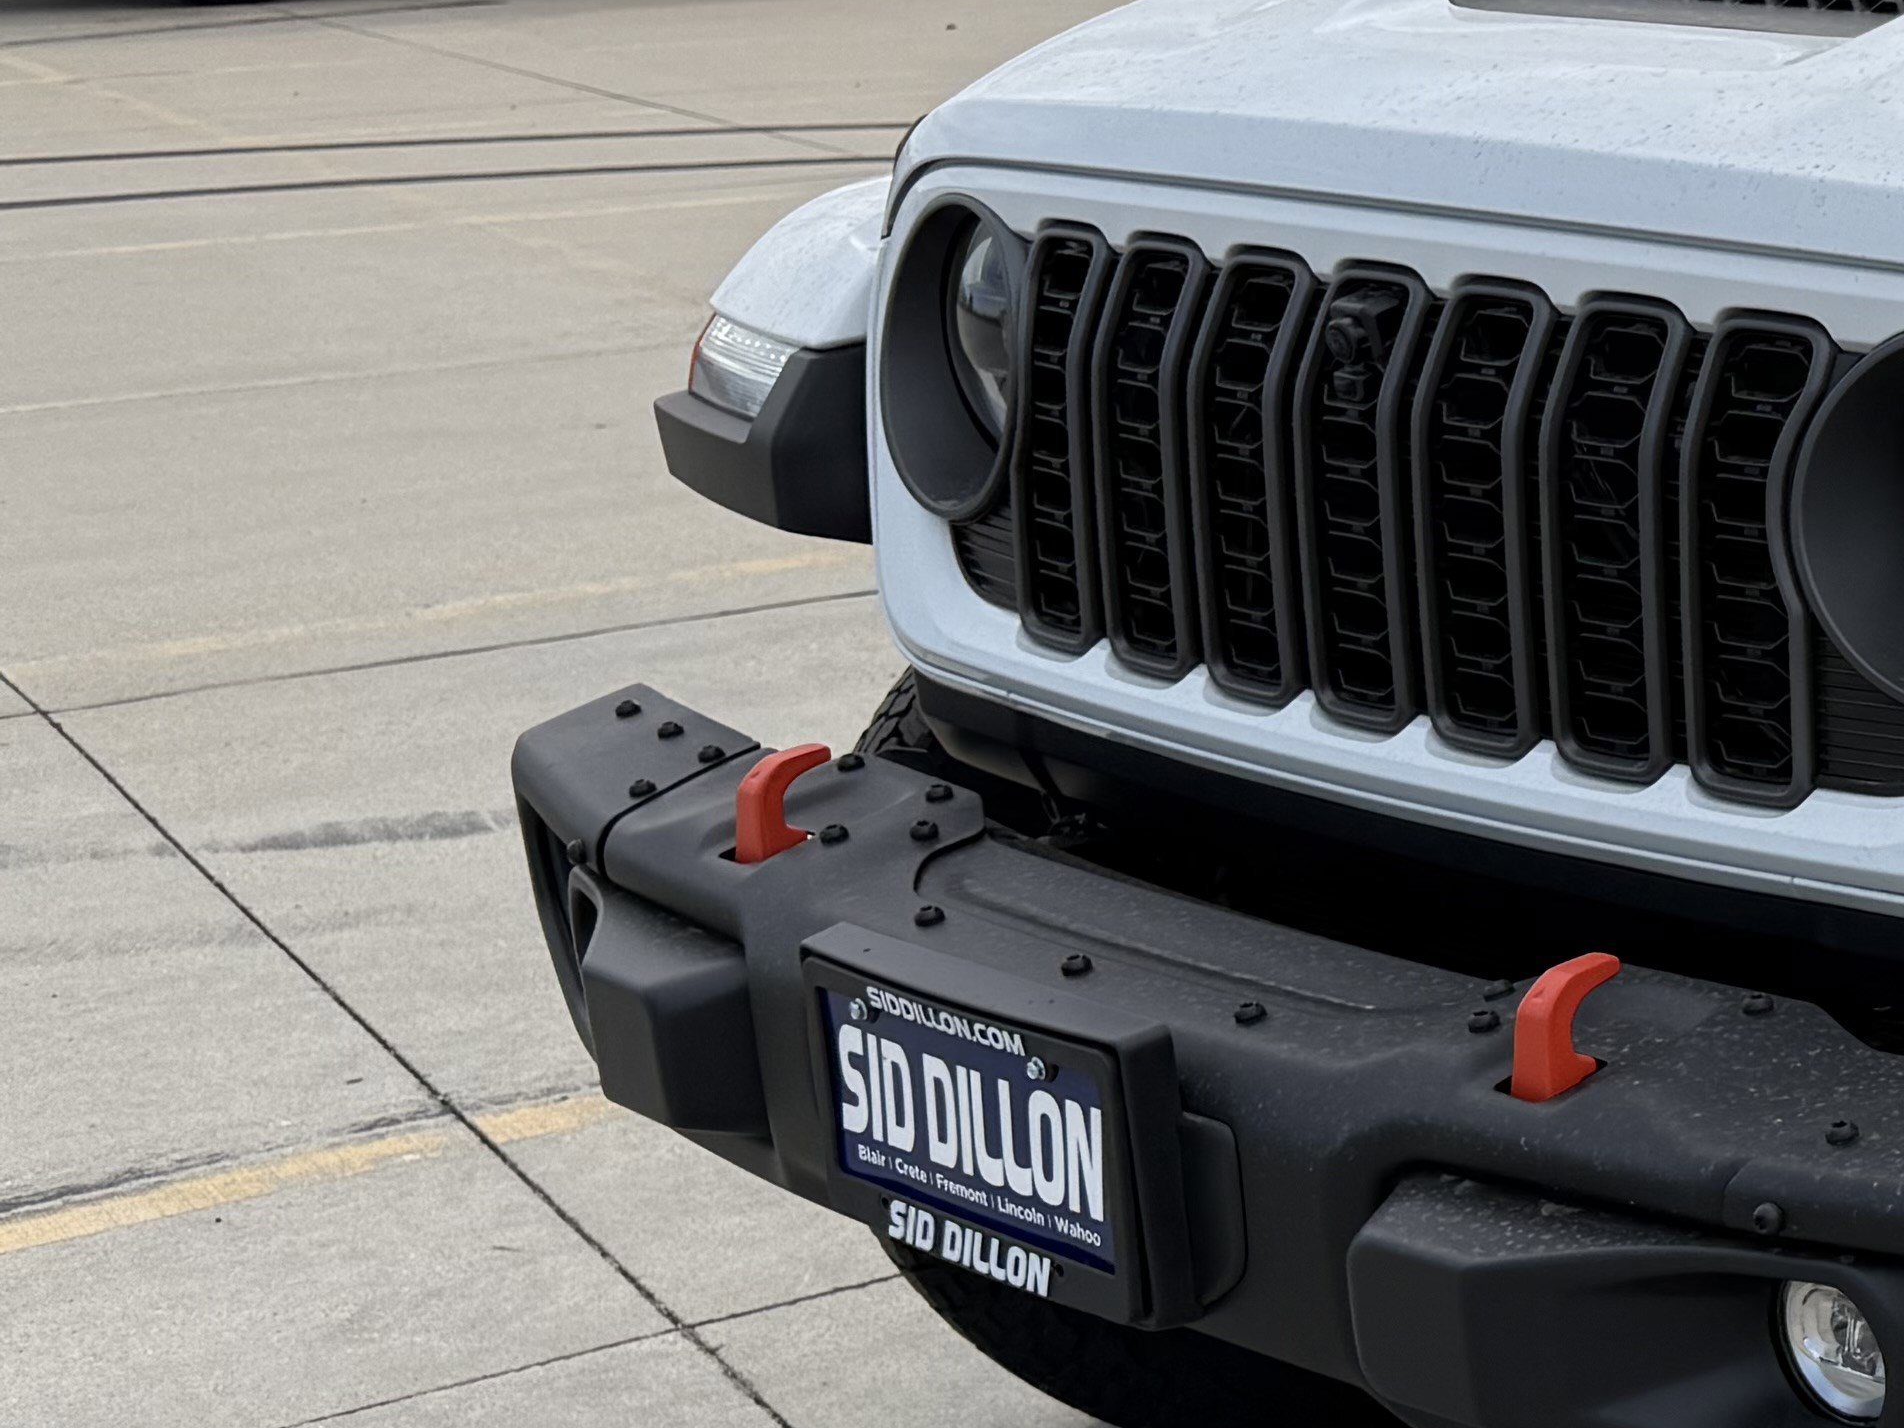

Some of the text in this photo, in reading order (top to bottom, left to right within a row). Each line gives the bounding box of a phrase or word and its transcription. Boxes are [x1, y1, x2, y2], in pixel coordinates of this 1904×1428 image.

[866, 985, 1026, 1057] SIDDILLON.COM
[838, 1023, 1105, 1223] SID DILLON
[858, 1143, 1102, 1248] Blair Crete Fremont Lincoln Wahoo
[887, 1199, 1052, 1299] SID DILLON
